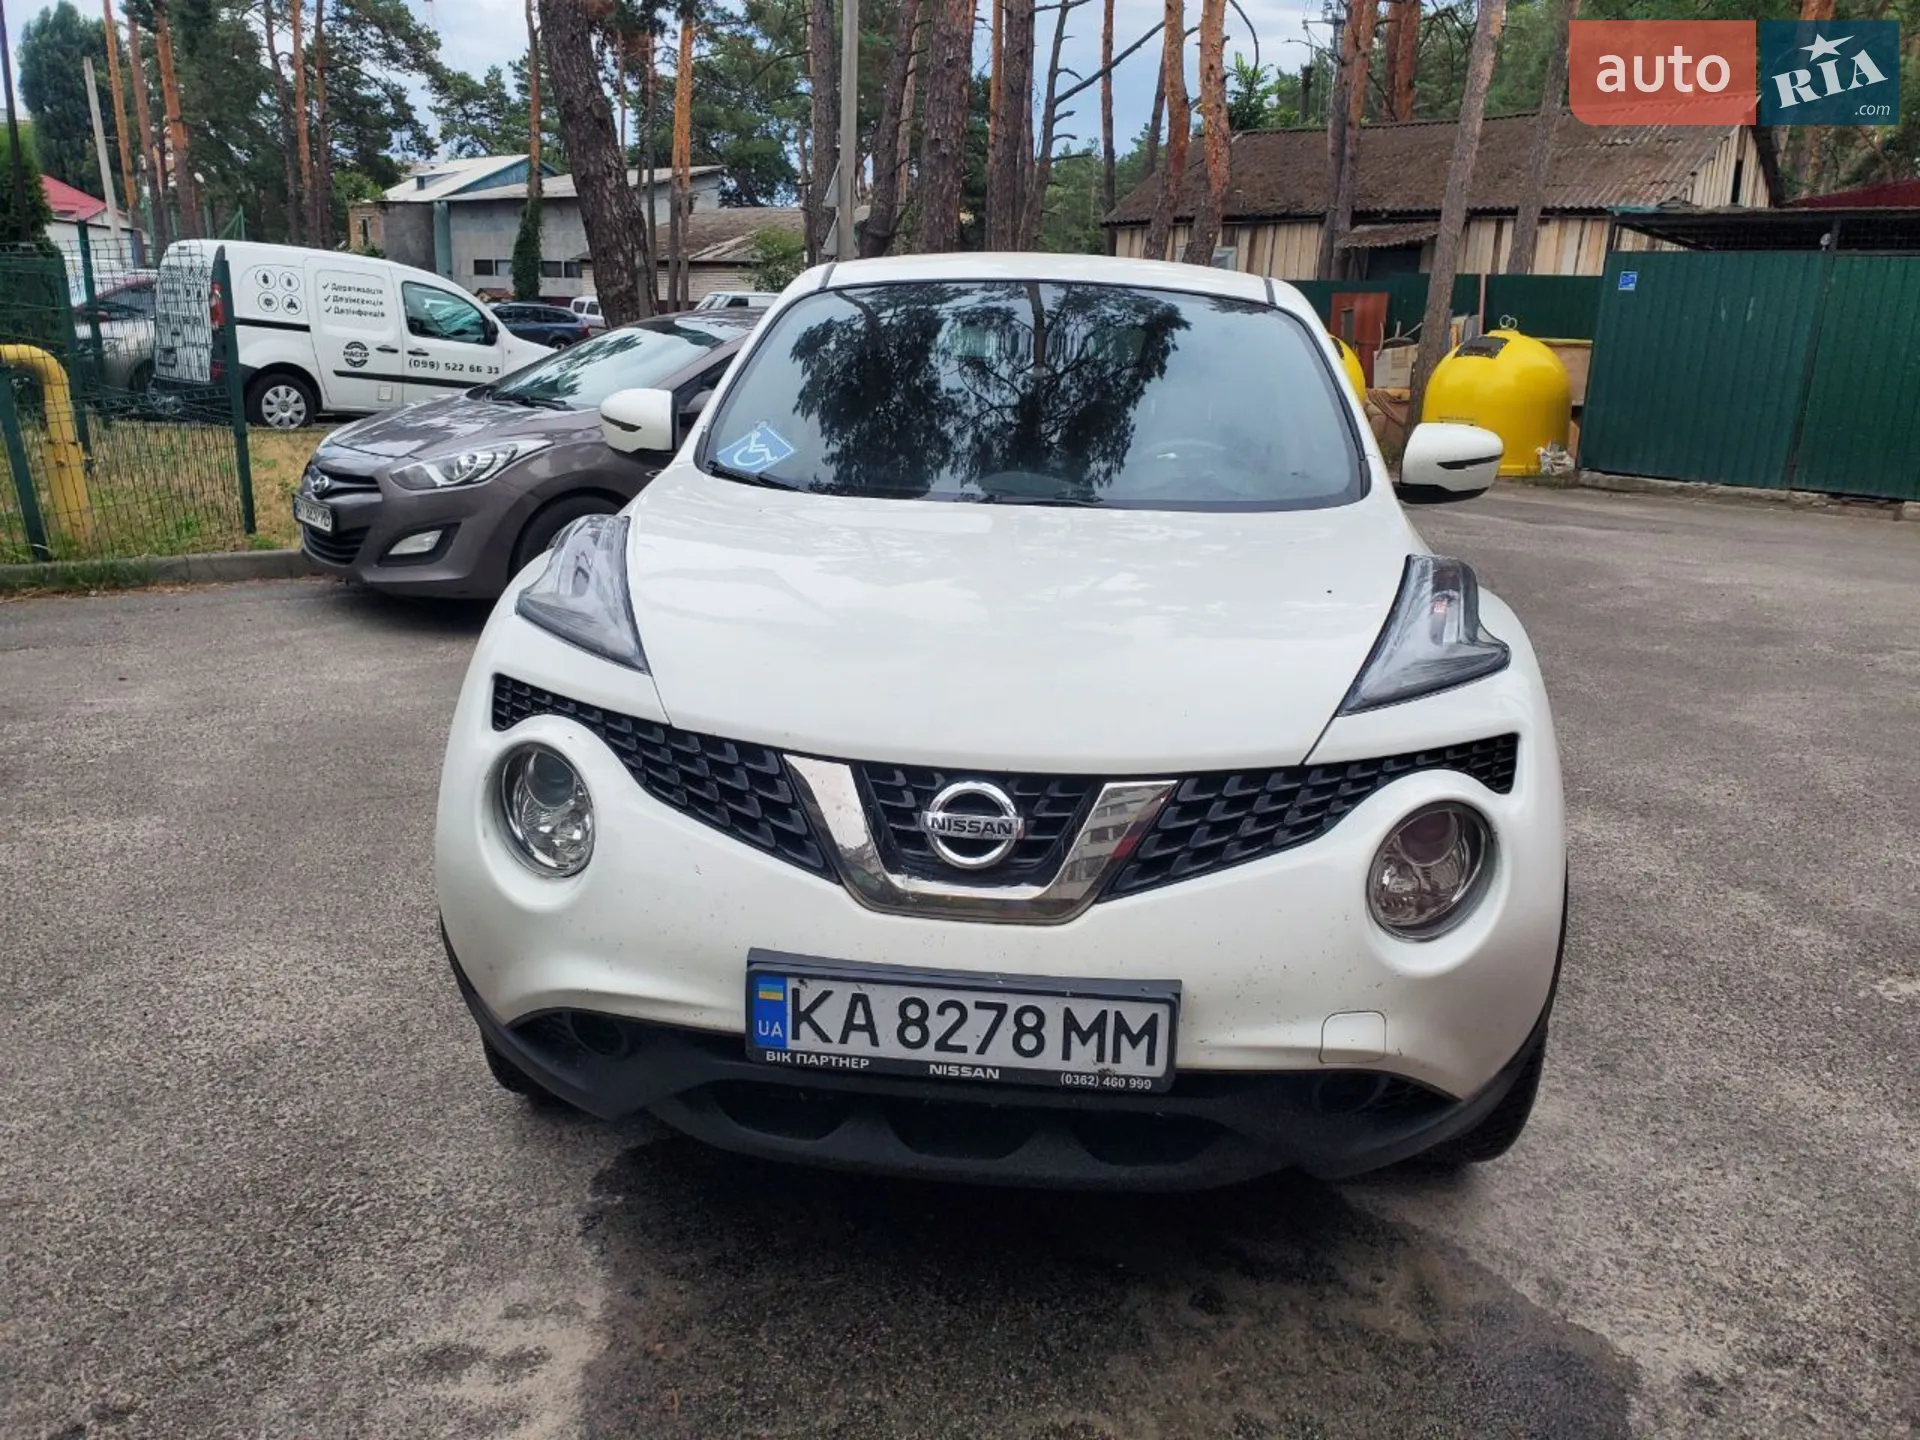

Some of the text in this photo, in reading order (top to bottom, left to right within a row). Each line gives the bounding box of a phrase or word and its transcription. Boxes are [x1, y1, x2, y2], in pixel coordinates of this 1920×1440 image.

[408, 358, 440, 371] (099)
[444, 362, 464, 372] 522
[469, 364, 482, 373] 66
[930, 817, 1013, 835] NISSAN
[758, 1020, 783, 1038] UA
[791, 987, 1159, 1066] KA 8278 MM
[796, 1054, 870, 1069] ПАРТНЕР
[929, 1064, 1000, 1080] NISSAN
[1060, 1072, 1152, 1090] (0362) 460 999
